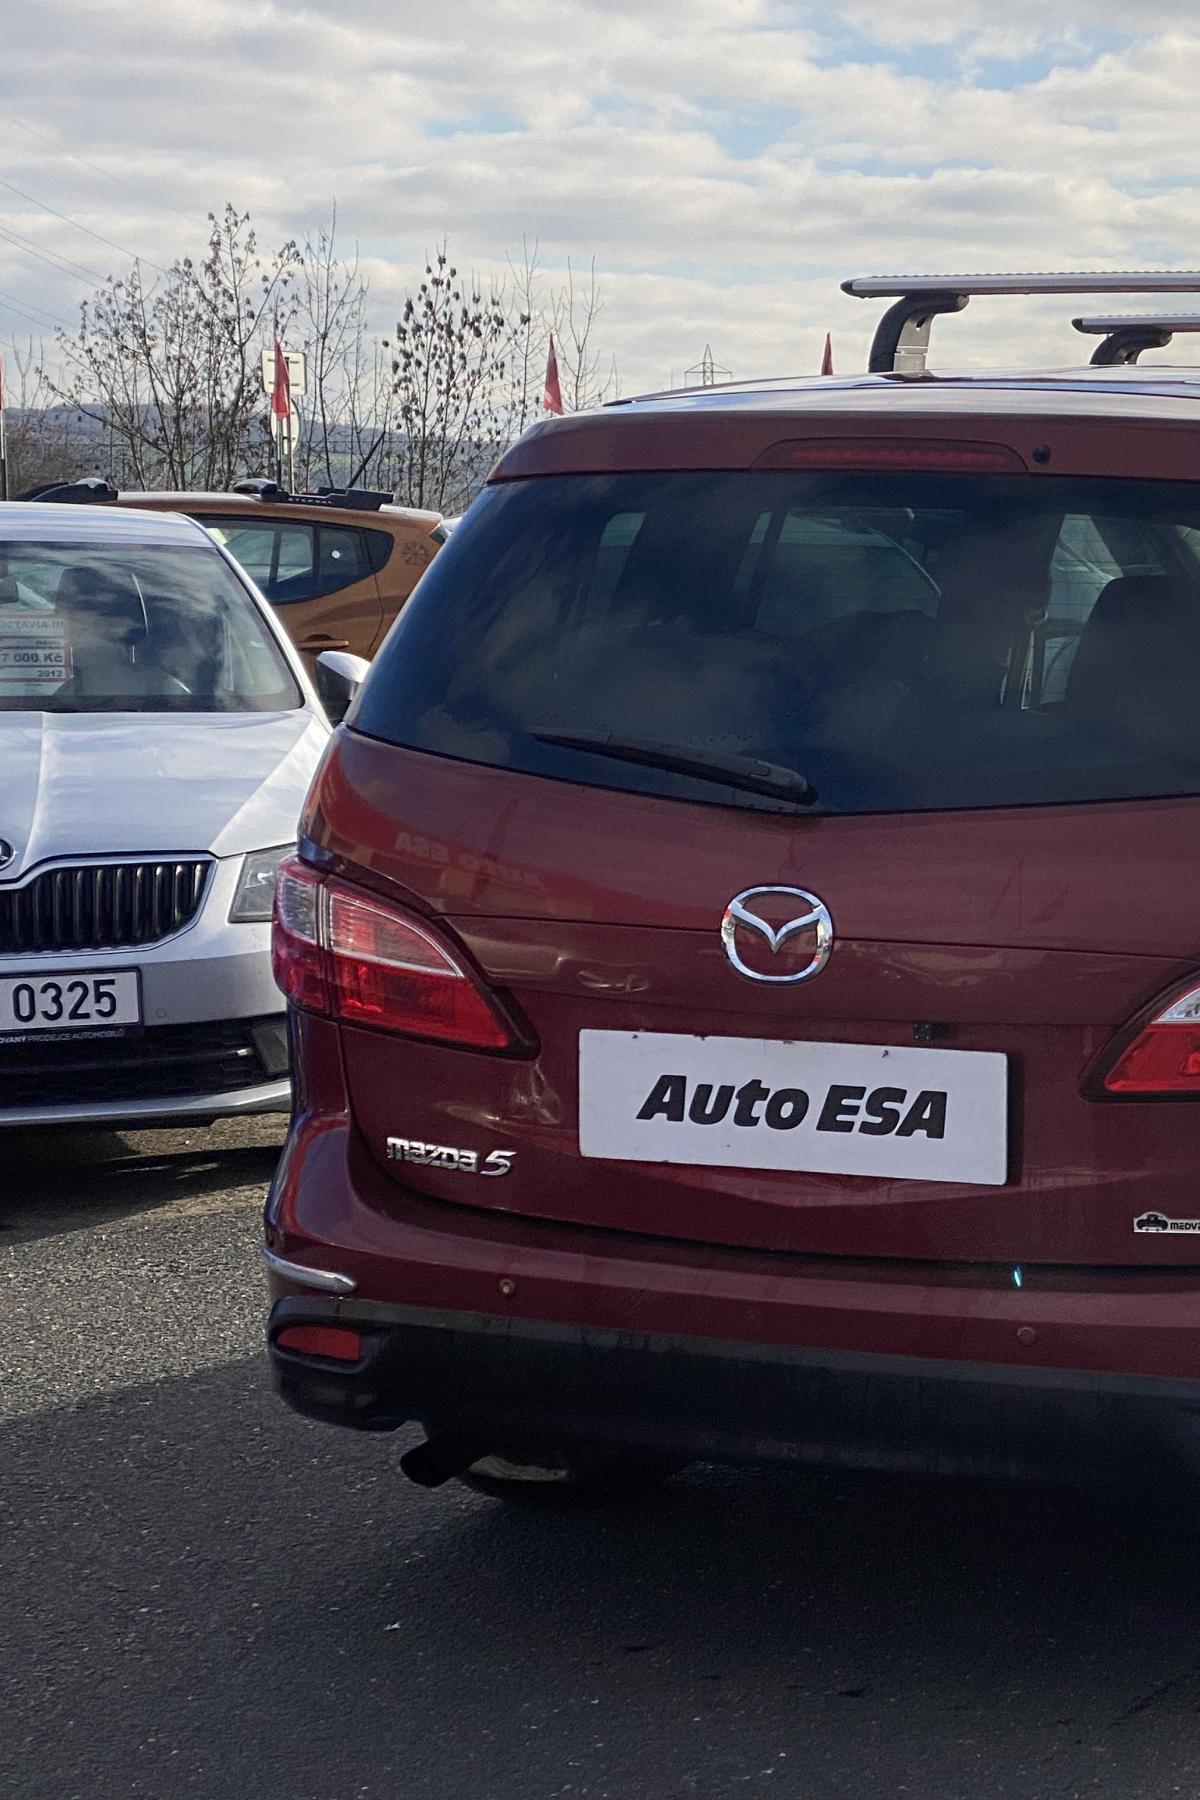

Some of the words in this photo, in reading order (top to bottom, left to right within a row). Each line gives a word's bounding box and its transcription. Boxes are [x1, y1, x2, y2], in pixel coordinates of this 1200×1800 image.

[37, 670, 63, 678] 2012
[12, 978, 117, 1023] 0325
[635, 1074, 810, 1131] Auto
[815, 1084, 948, 1140] ESA
